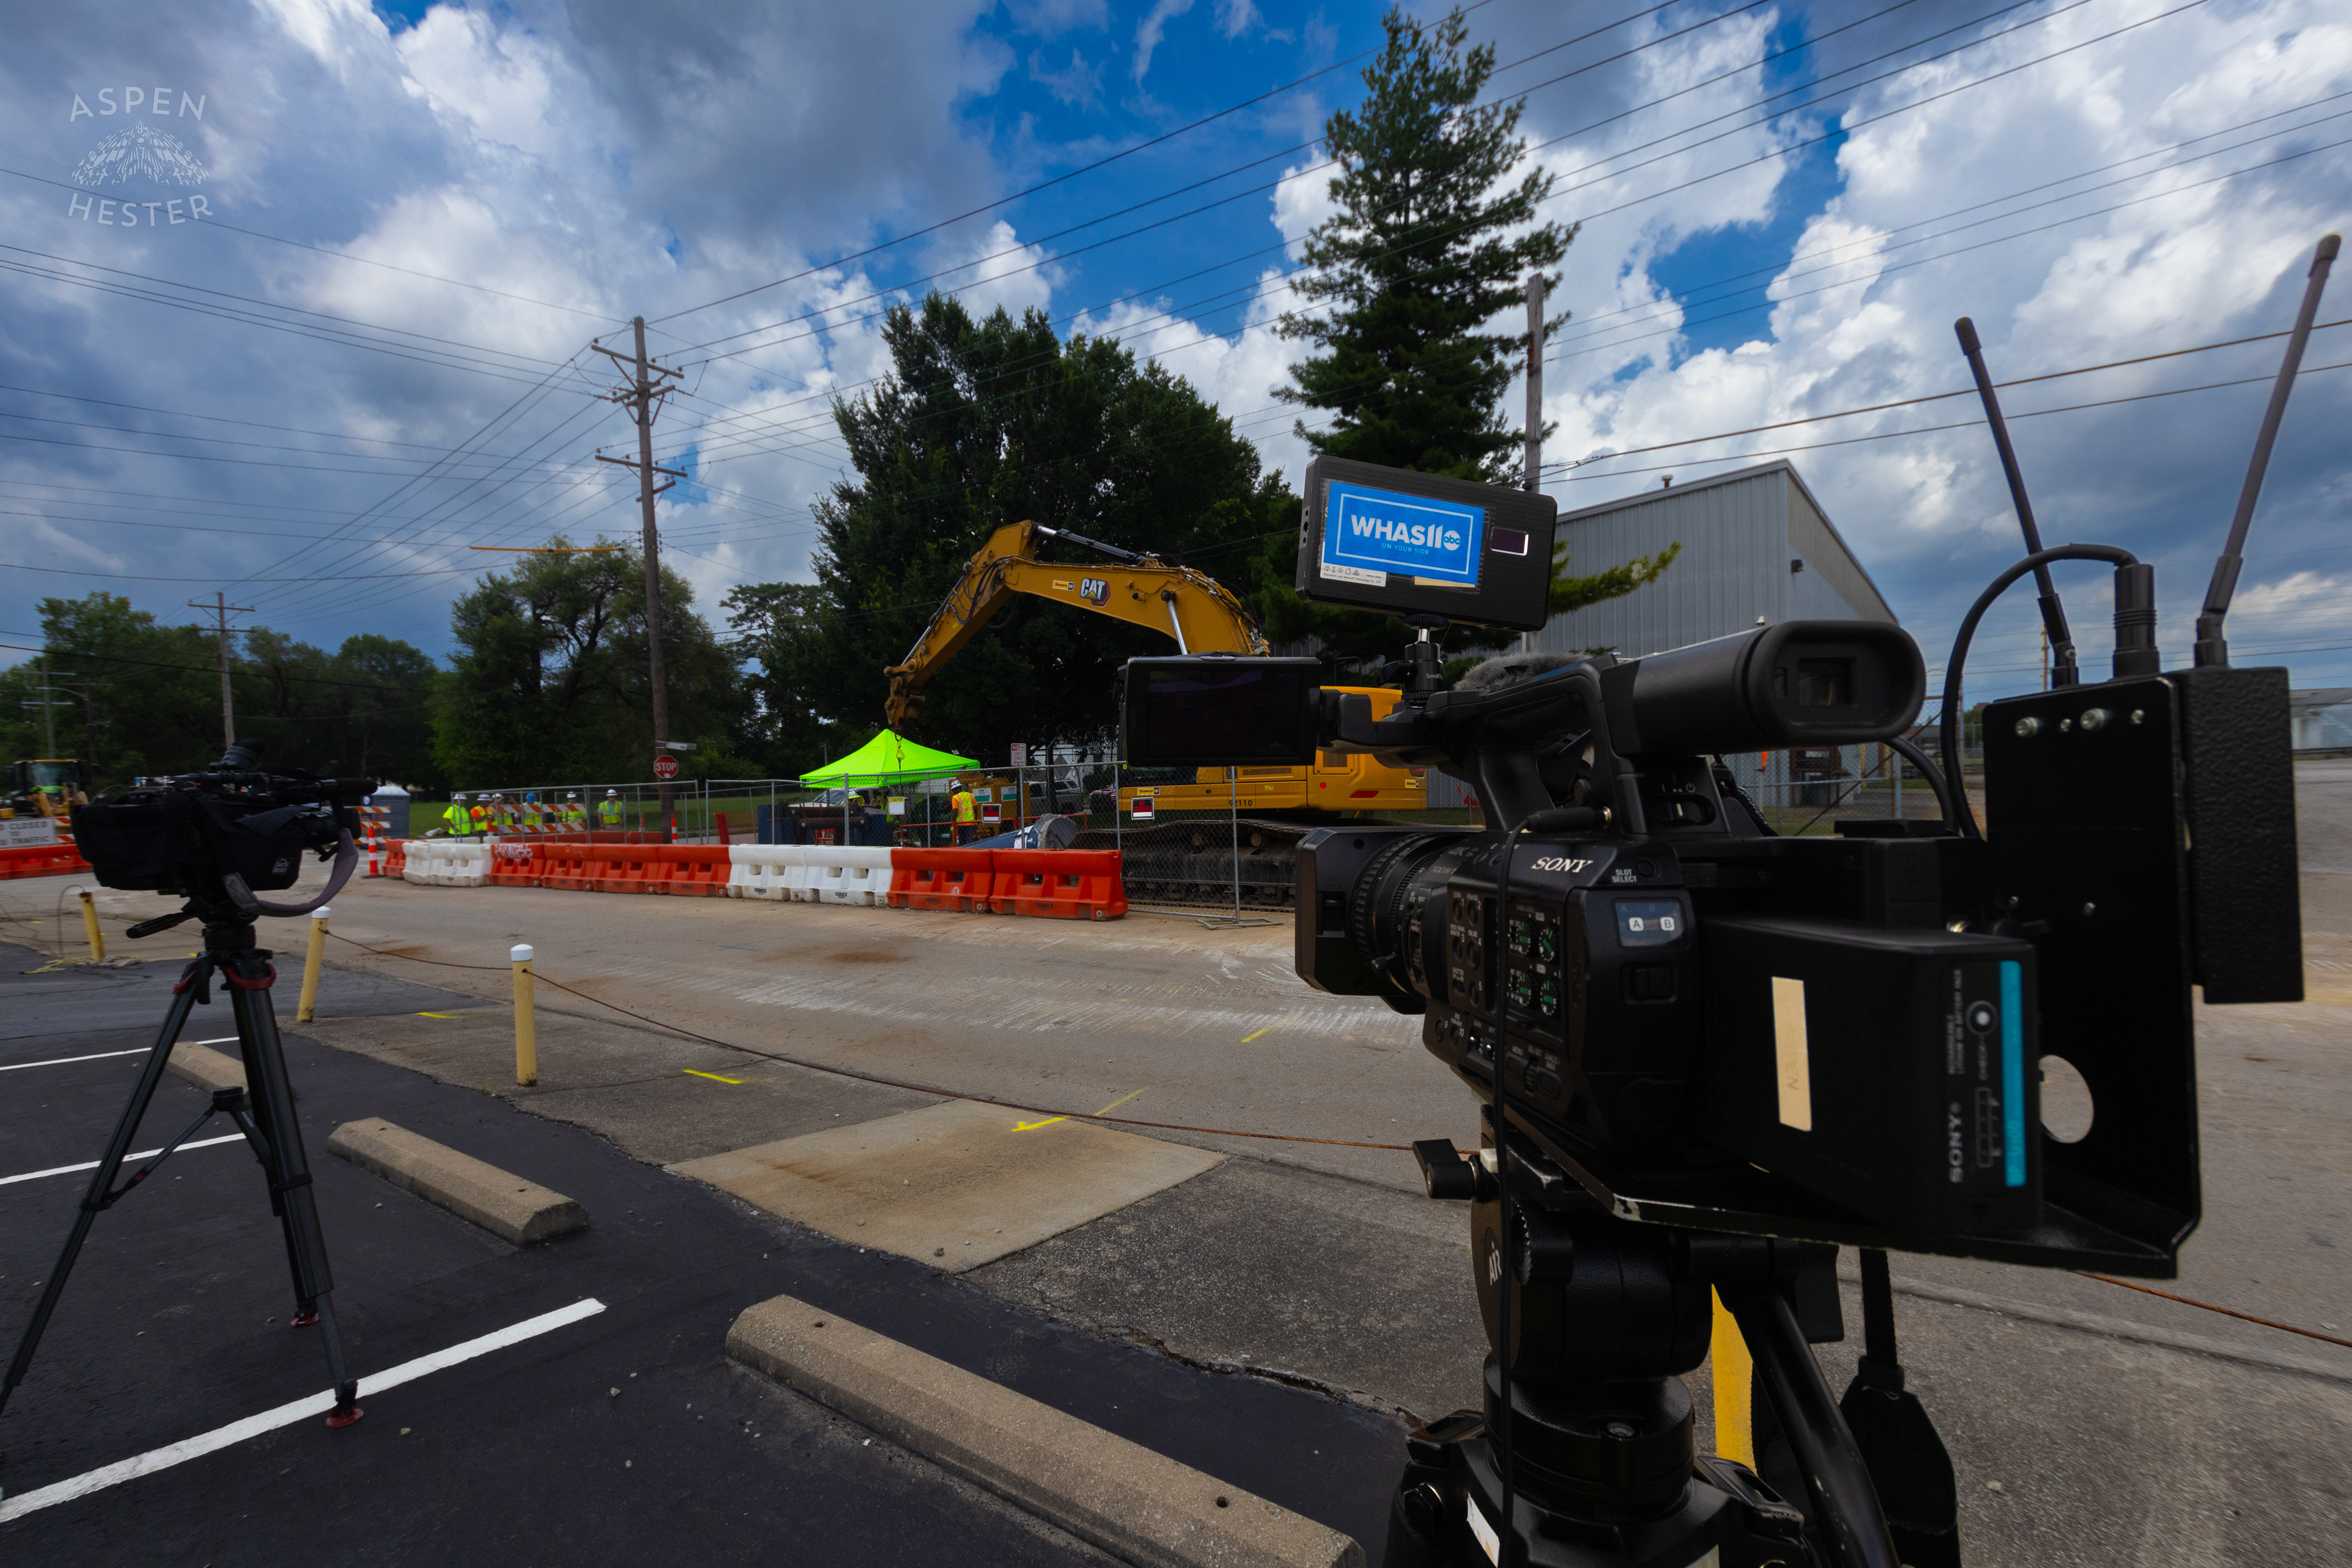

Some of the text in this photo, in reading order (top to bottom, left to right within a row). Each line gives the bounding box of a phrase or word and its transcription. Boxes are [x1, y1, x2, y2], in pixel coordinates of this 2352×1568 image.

[1080, 578, 1106, 600] CAT
[655, 763, 676, 771] STOP
[12, 836, 50, 845] TRAFFIC
[1531, 857, 1594, 873] SONY
[1477, 900, 1482, 910] 2
[1479, 981, 1483, 991] 5
[1460, 1027, 1464, 1037] 10
[1512, 1045, 1524, 1057] MENU
[1546, 1060, 1556, 1071] BACK
[1948, 1112, 1964, 1183] SONY
